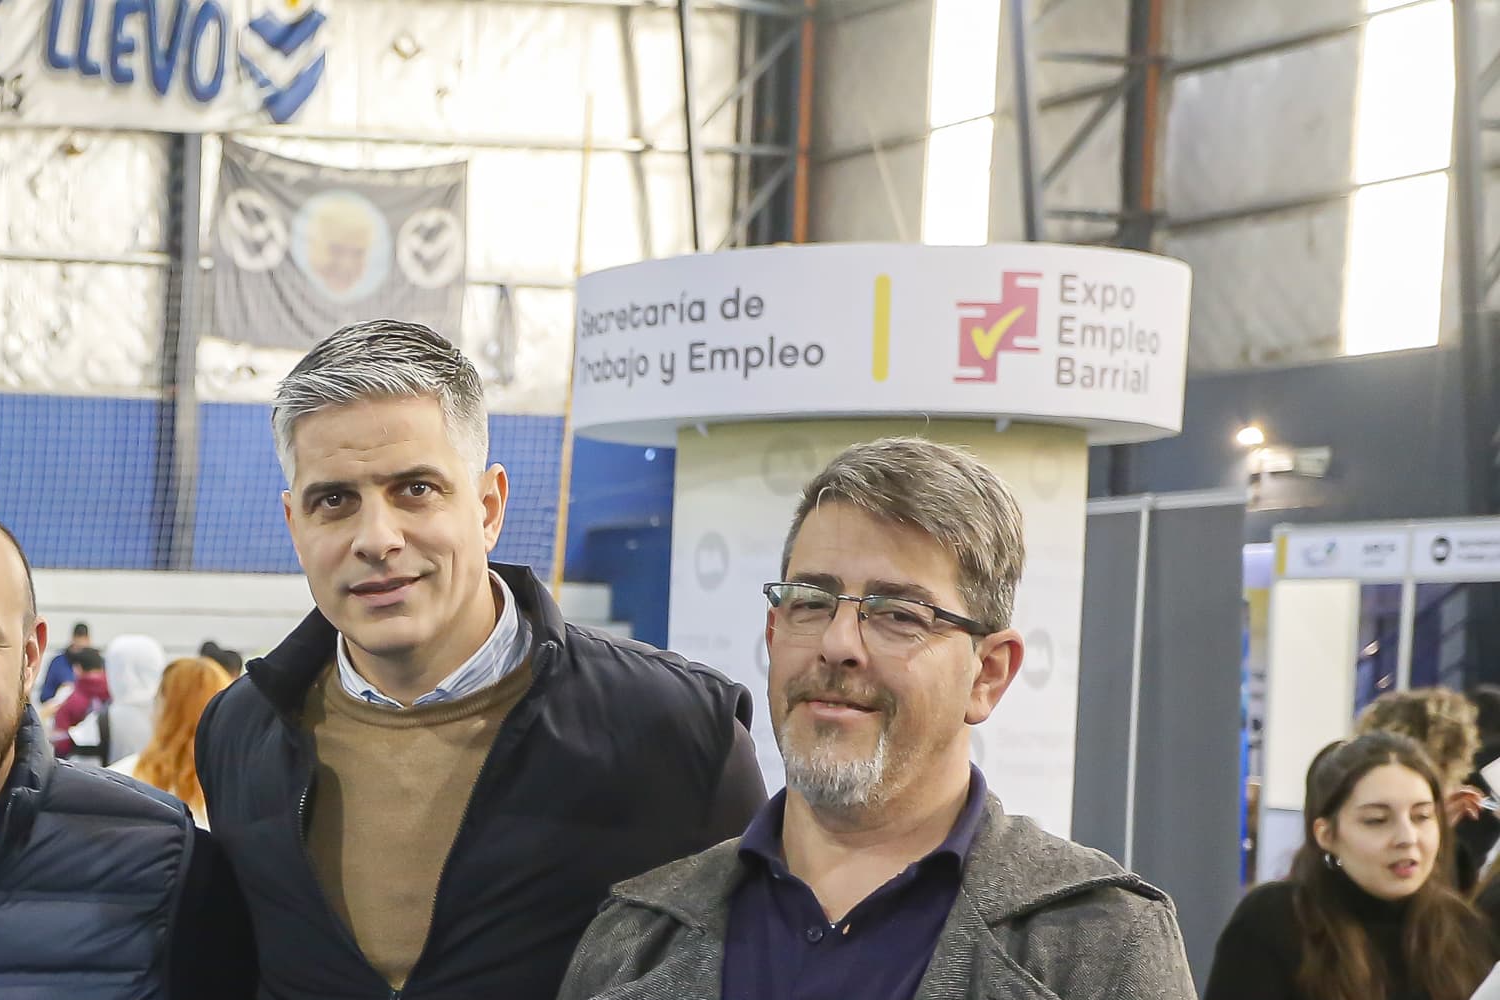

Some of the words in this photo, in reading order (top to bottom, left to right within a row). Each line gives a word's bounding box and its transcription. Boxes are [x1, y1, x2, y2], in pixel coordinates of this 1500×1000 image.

[47, 0, 227, 103] LLEVO
[719, 287, 764, 320] de
[1059, 273, 1137, 313] Expo
[1057, 315, 1162, 356] Empleo
[660, 352, 675, 385] y
[688, 336, 825, 379] Empleo
[1055, 356, 1150, 394] Barrial
